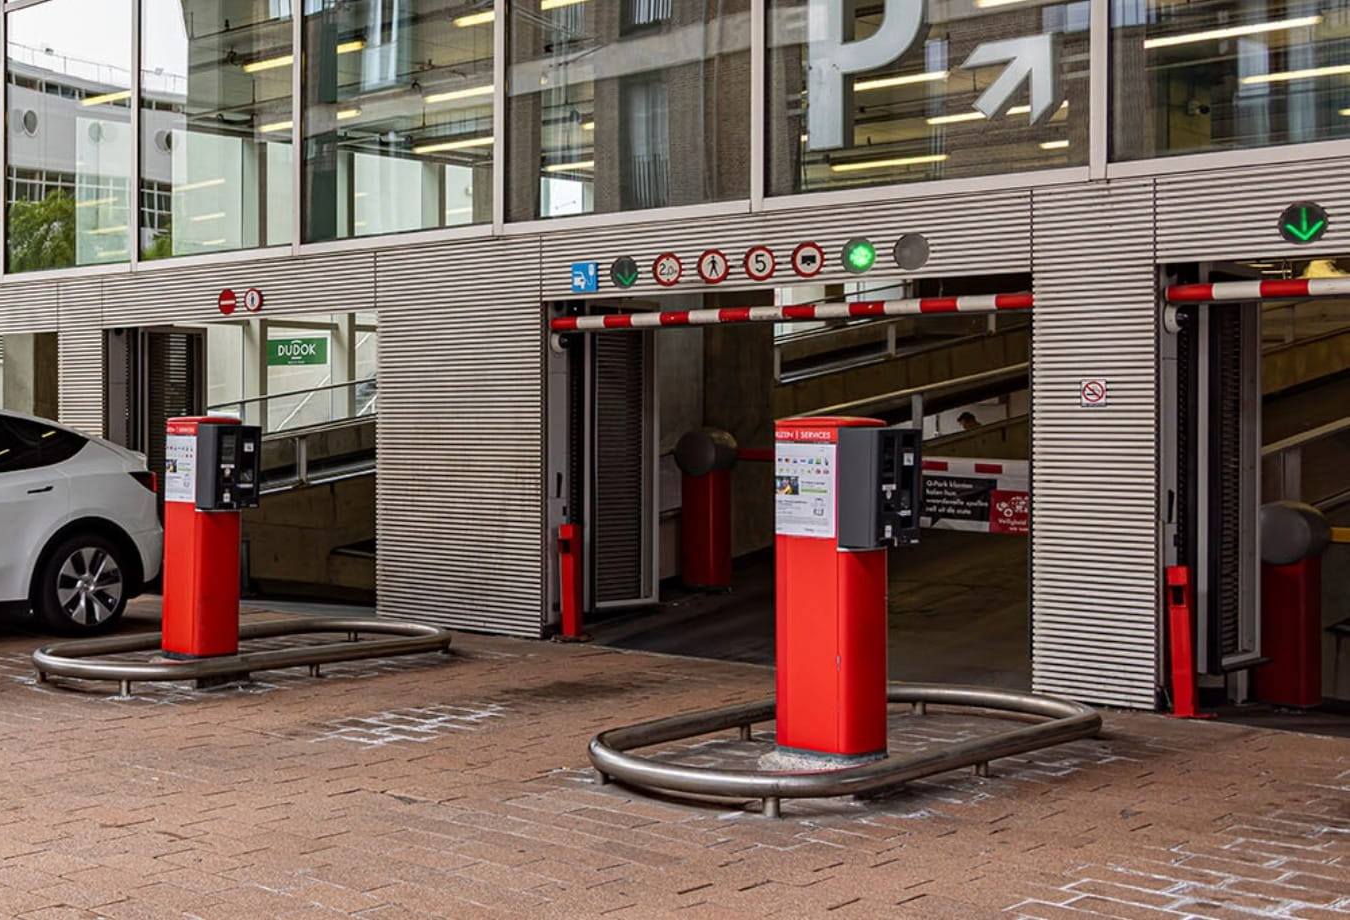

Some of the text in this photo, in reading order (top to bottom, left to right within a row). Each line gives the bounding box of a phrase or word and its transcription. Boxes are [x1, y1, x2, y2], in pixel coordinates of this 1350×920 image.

[808, 0, 924, 150] P
[755, 254, 767, 273] 5
[278, 344, 316, 356] DUDOK
[800, 431, 831, 439] SERVICES
